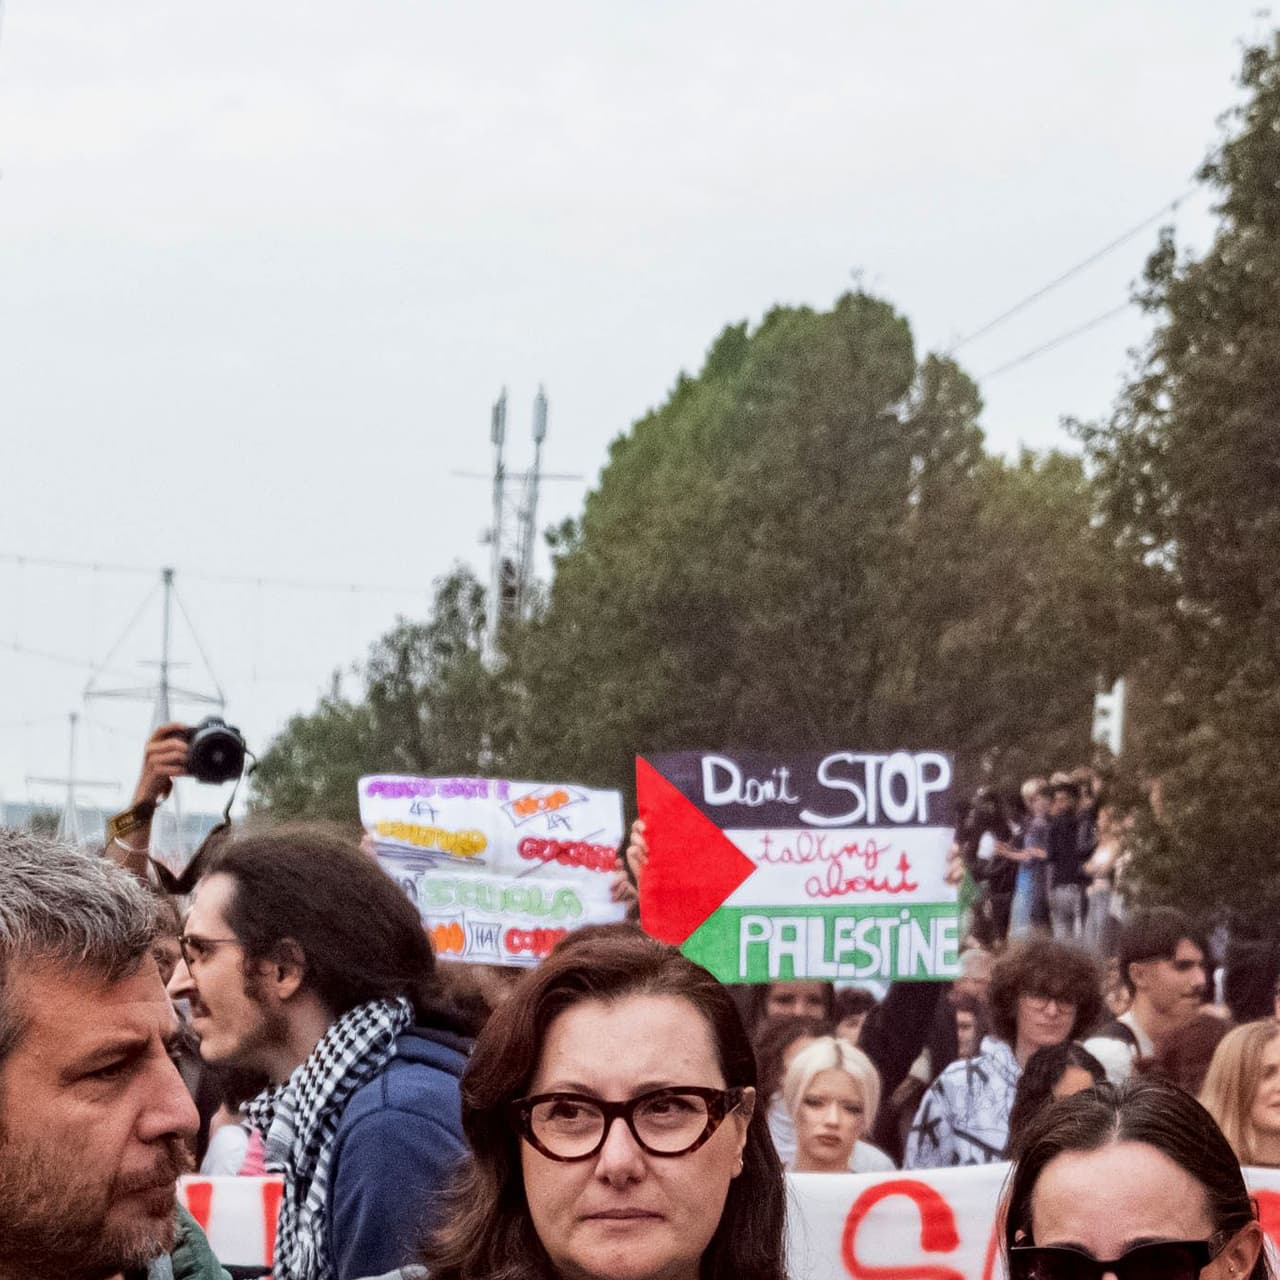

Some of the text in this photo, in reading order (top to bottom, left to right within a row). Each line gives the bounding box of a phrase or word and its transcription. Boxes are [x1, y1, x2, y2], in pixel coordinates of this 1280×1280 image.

[798, 751, 952, 827] STOP
[756, 830, 893, 870] talking
[804, 850, 919, 898] about
